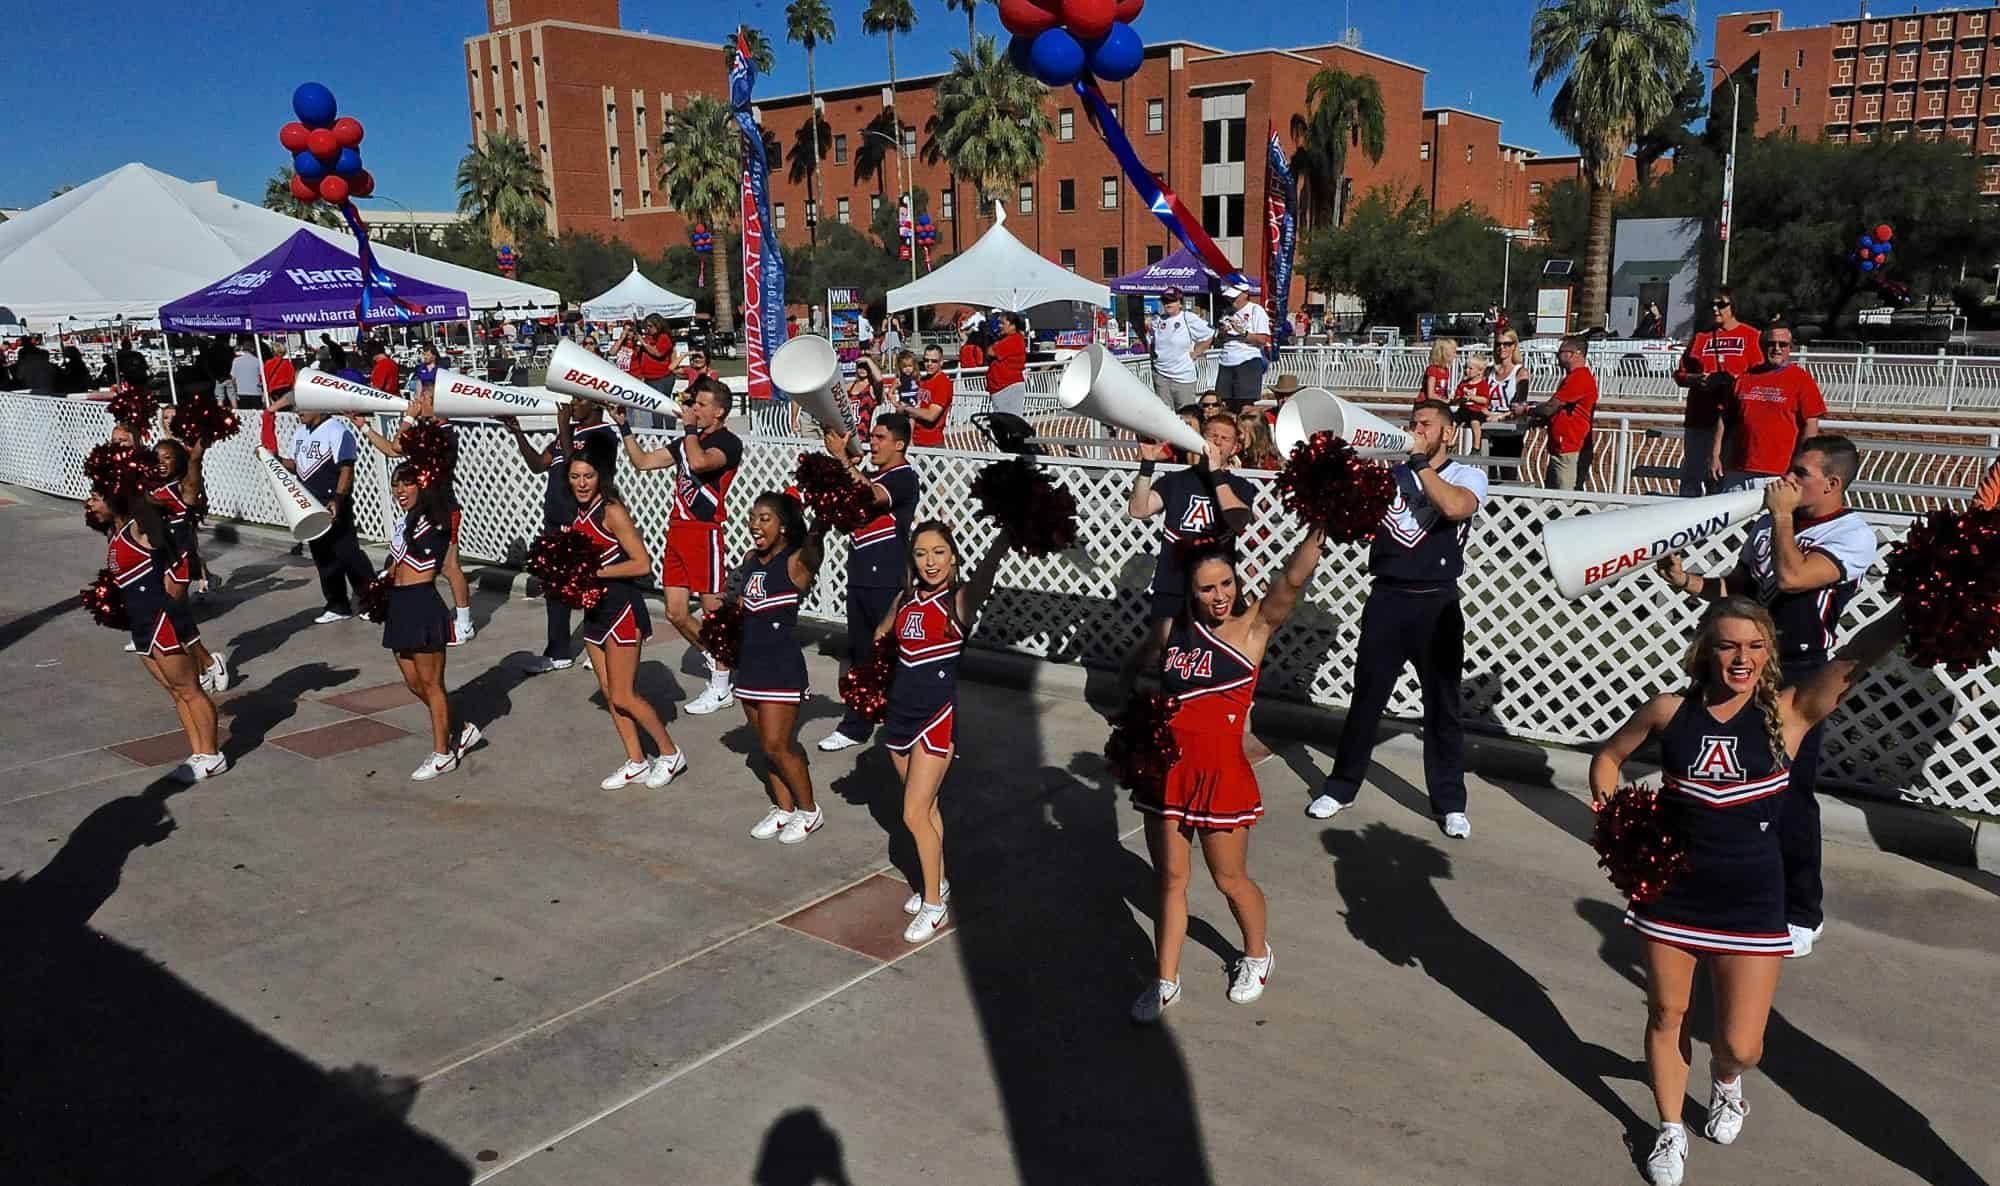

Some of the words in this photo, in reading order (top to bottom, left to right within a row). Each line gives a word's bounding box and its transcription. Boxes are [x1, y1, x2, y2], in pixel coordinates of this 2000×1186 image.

[831, 288, 850, 304] WIN
[745, 243, 771, 385] WILDCAT
[1180, 494, 1215, 533] A
[744, 571, 768, 600] A
[902, 611, 926, 640] A
[1688, 735, 1747, 783] A
